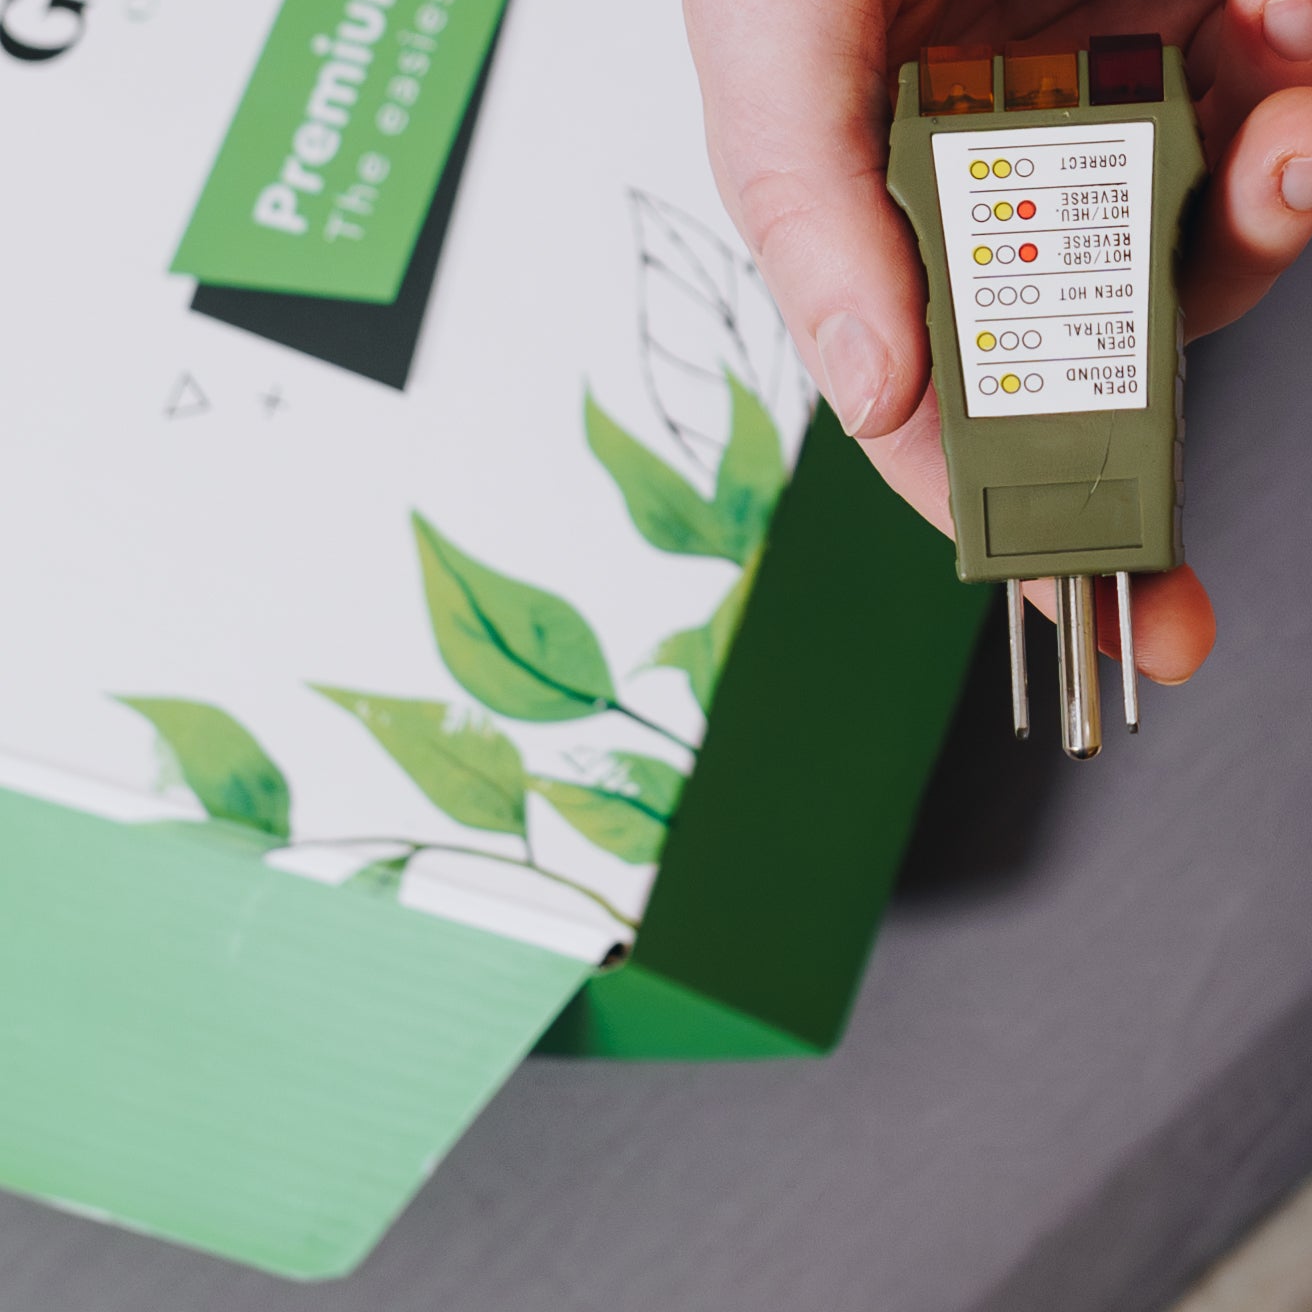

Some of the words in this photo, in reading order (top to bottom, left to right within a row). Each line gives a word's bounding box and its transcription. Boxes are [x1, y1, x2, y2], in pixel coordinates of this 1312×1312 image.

[1060, 153, 1128, 170] CORRECT
[325, 152, 391, 242] The
[1061, 189, 1129, 205] REVERSE
[1055, 206, 1130, 222] HOT/HEU.
[1062, 233, 1131, 249] REVERSE
[1057, 249, 1132, 265] HOT/GRD.
[1058, 285, 1087, 301] HOT
[1095, 284, 1134, 299] OPEN
[1063, 320, 1135, 336] NEUTRAL
[1096, 335, 1136, 350] OPEN
[1066, 364, 1137, 381] GROUND
[1094, 381, 1138, 395] OPEN
